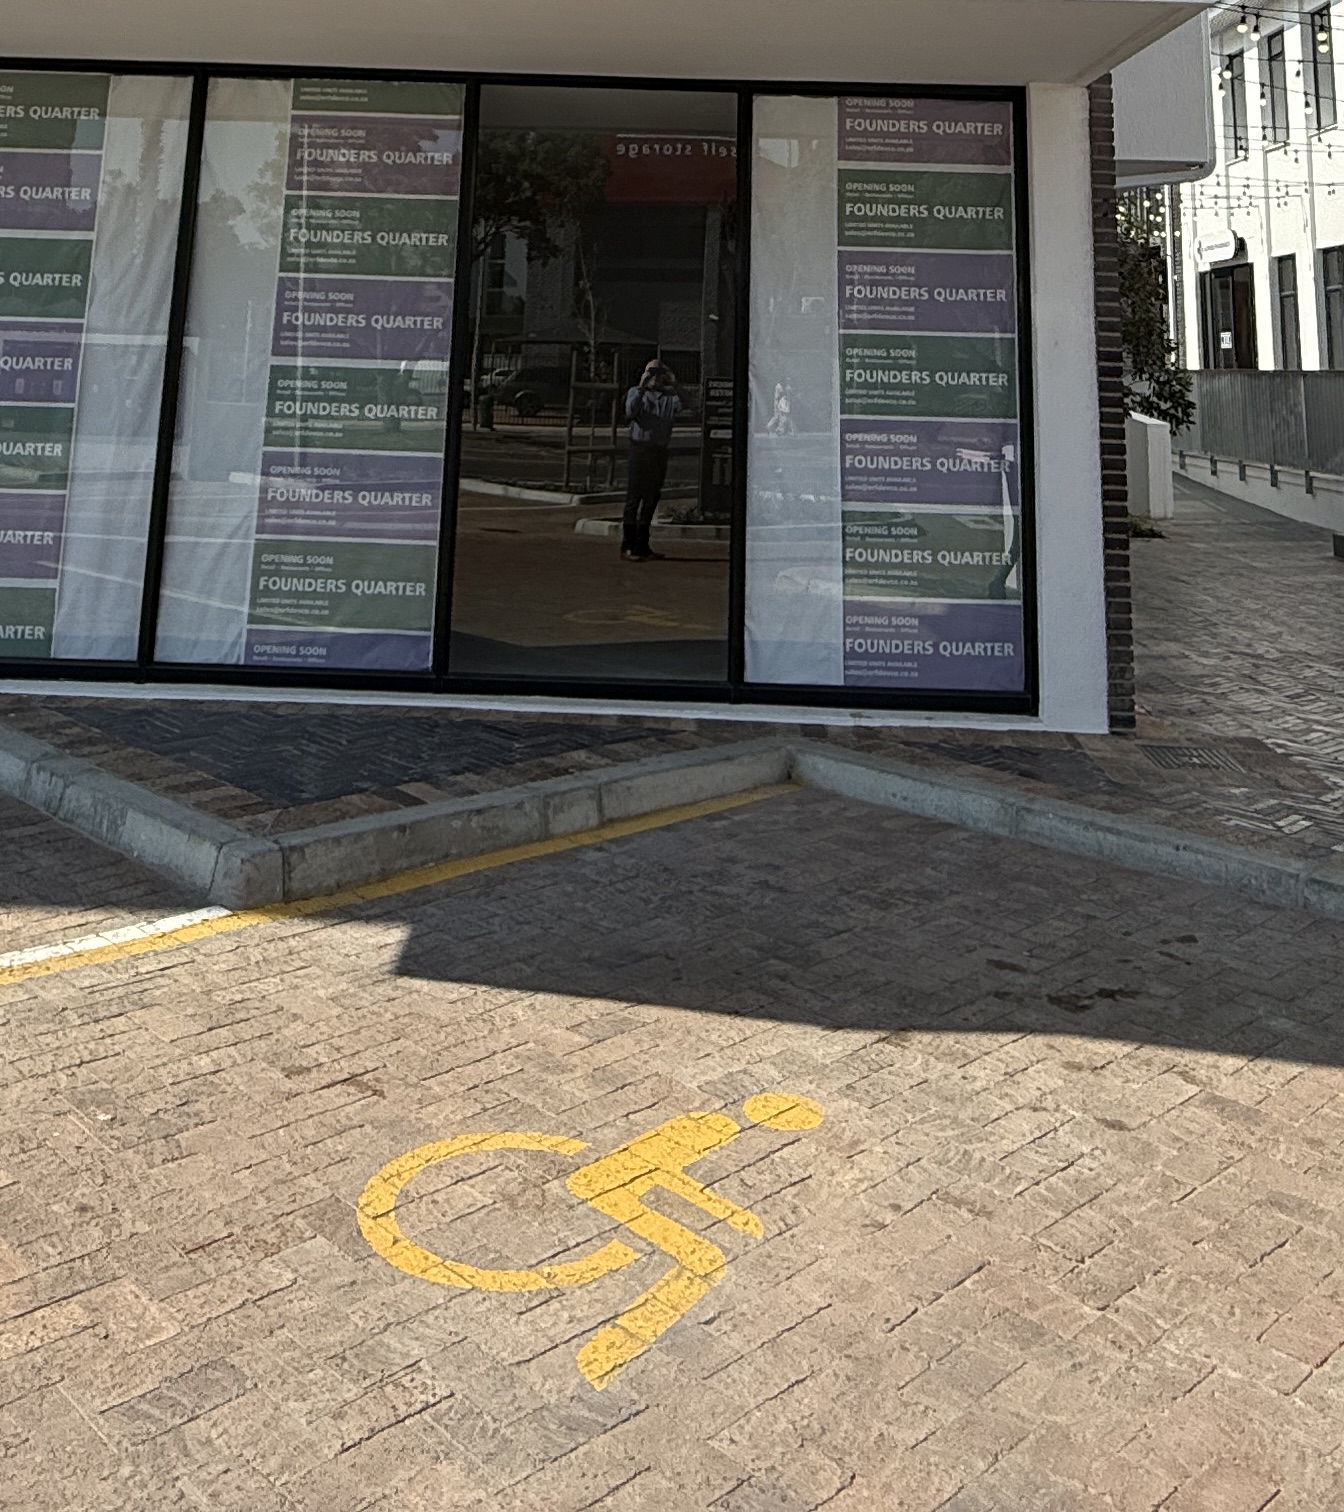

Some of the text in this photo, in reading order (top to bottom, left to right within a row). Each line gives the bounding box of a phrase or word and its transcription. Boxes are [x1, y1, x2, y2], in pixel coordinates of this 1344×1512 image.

[29, 107, 100, 120] QUARTER
[845, 118, 1003, 136] FOUNDERS QUARTER
[296, 148, 453, 165] FOUNDERS QUARTER
[19, 186, 91, 200] QUARTER
[846, 182, 915, 192] OPENING SOON
[845, 203, 1004, 220] FOUNDERS QUARTER
[289, 228, 449, 246] FOUNDERS QUARTER
[846, 264, 915, 274] OPENING SOON
[9, 272, 83, 286] QUARTER
[845, 285, 1006, 302] FOUNDERS QUARTER
[282, 312, 443, 329] FOUNDERS QUARTER
[846, 347, 916, 358] OPENING SOON
[0, 356, 73, 370] QUARTER
[845, 369, 1008, 387] FOUNDERS QUARTER
[275, 401, 438, 419] FOUNDERS QUARTER
[845, 433, 917, 443] OPENING SOON
[270, 465, 341, 476] OPENING SOON
[845, 455, 1010, 473] FOUNDERS QUARTER
[267, 487, 432, 506] FOUNDERS QUARTER
[845, 526, 917, 536] OPENING SOON
[261, 553, 334, 564] OPENING SOON
[845, 548, 1012, 566] FOUNDERS QUARTER
[259, 576, 426, 596] FOUNDERS QUARTER
[845, 616, 919, 626] OPENING SOON
[253, 644, 327, 656] OPENING SOON
[845, 639, 1014, 657] FOUNDERS QUARTER
